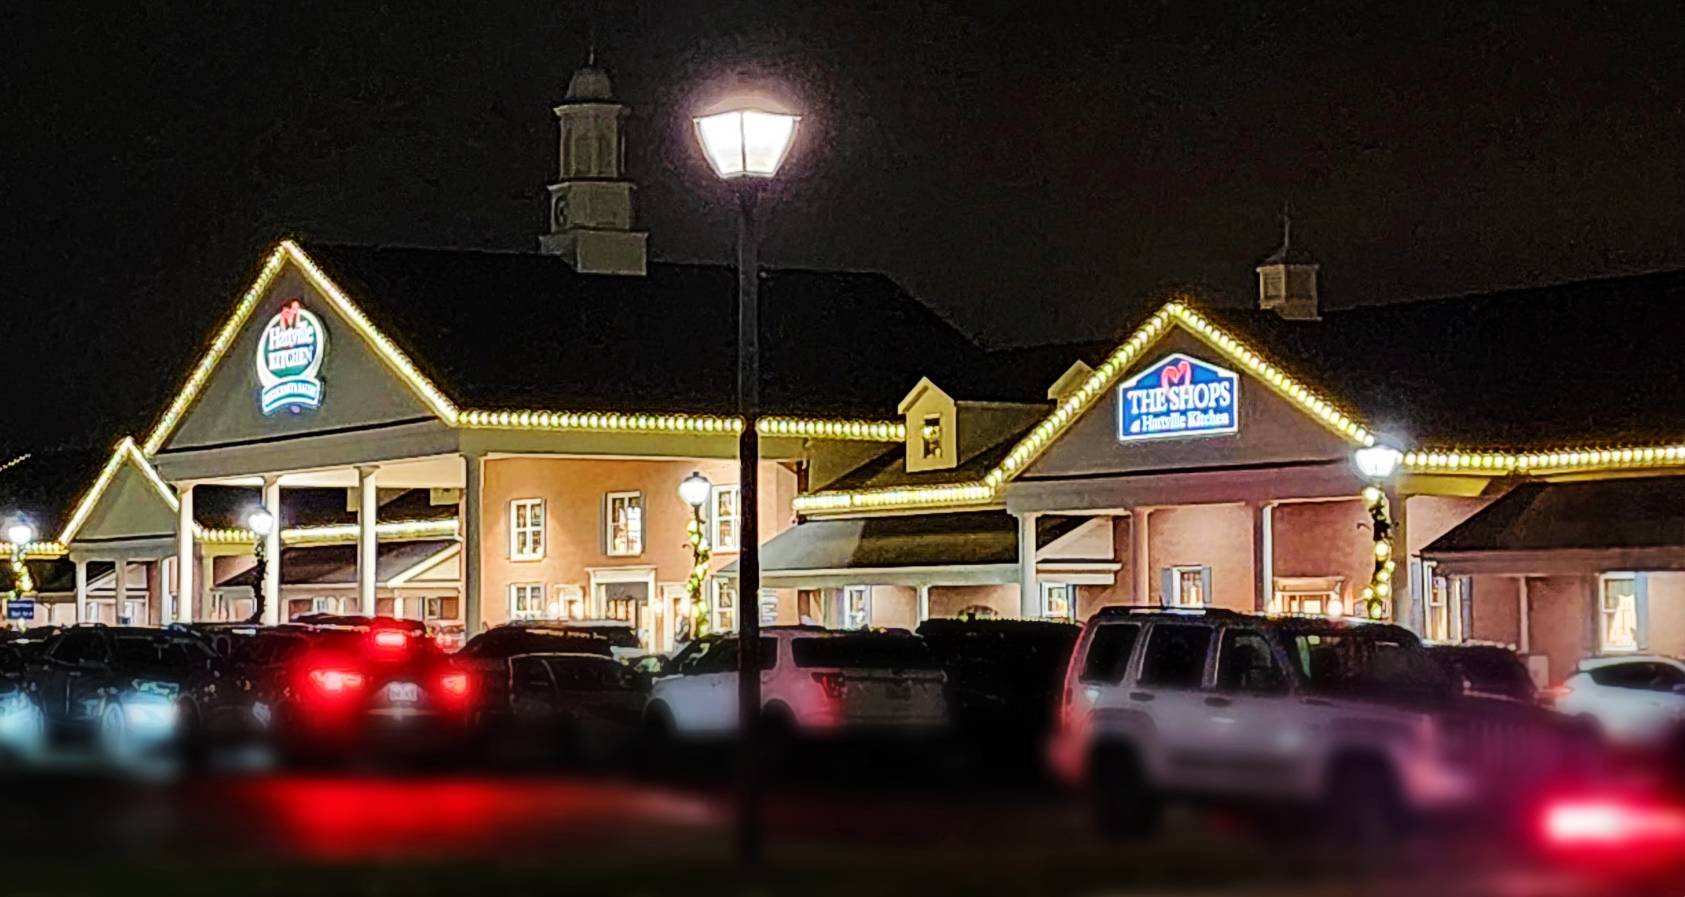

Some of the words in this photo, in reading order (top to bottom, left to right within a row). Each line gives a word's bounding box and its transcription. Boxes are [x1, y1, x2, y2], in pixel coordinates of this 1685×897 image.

[1127, 387, 1168, 414] THE
[1169, 381, 1231, 410] SHOPS
[1187, 409, 1230, 428] Kitchen
